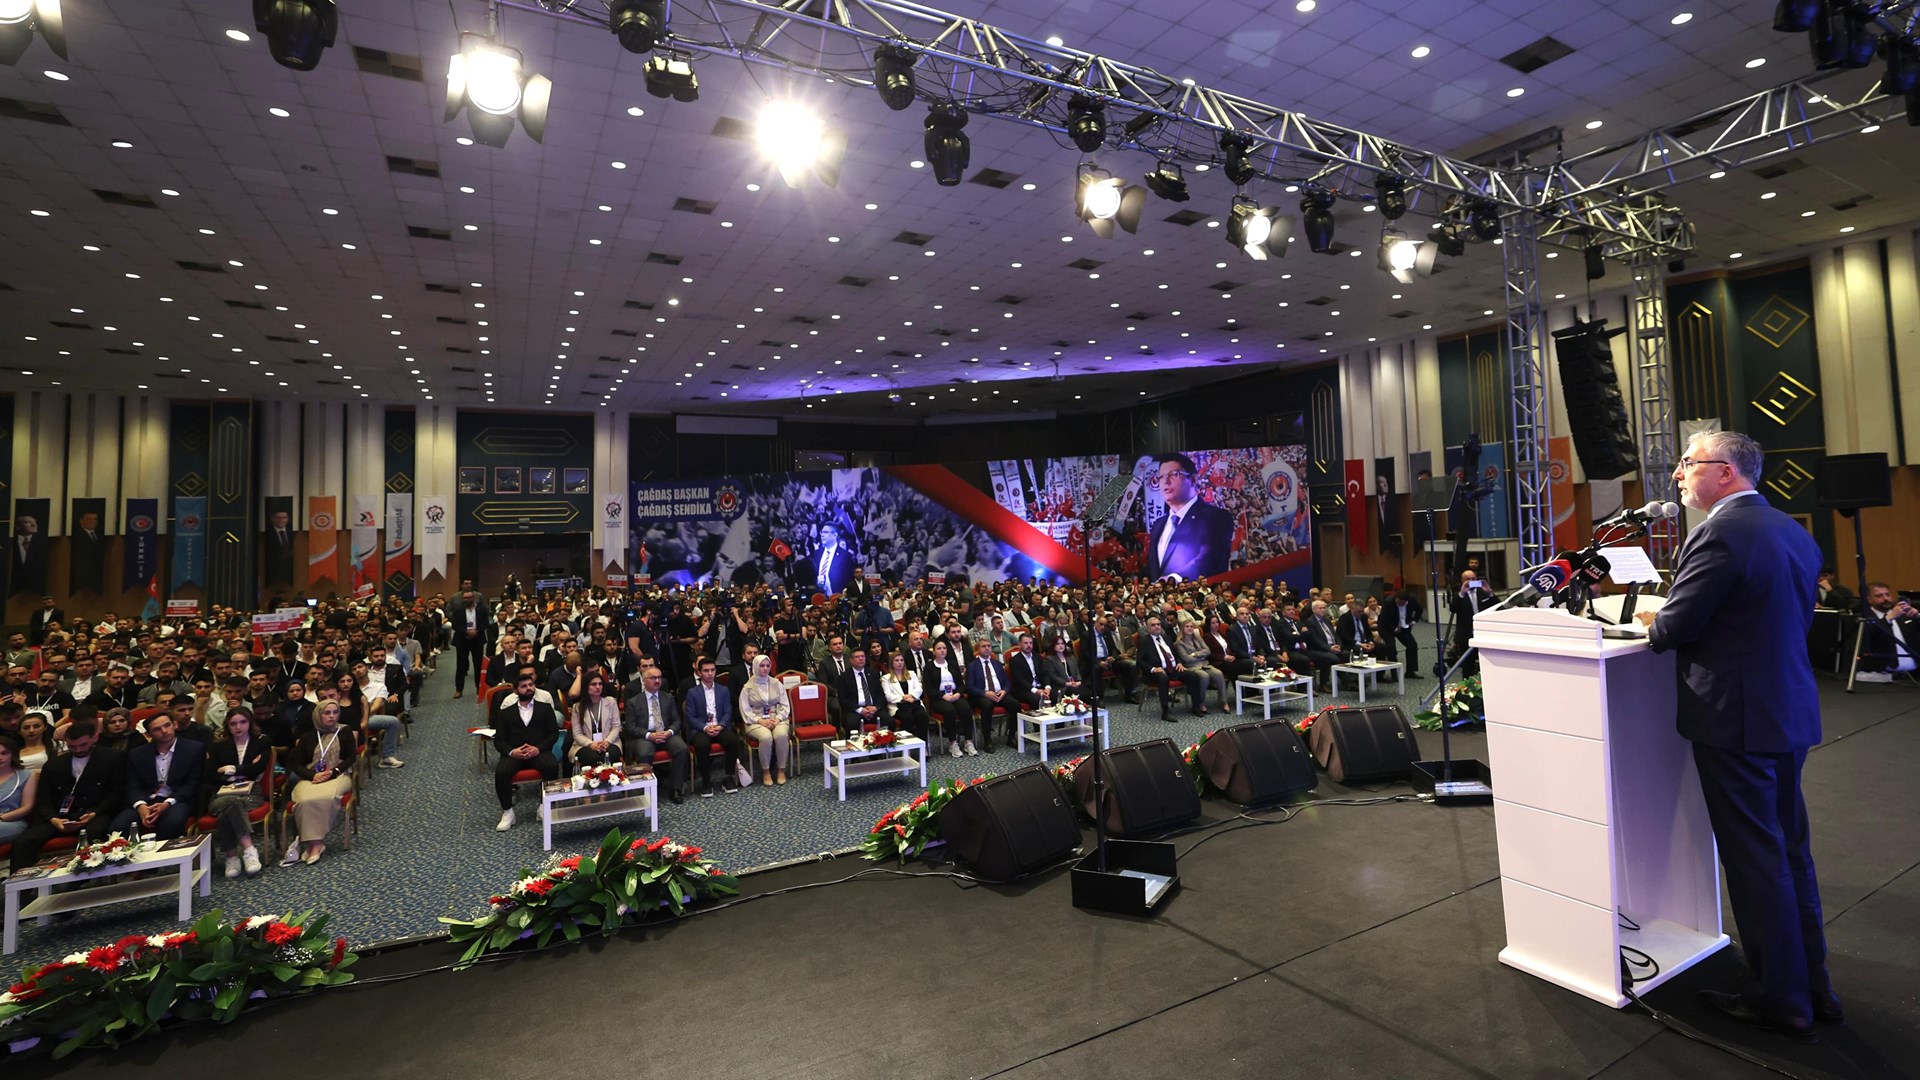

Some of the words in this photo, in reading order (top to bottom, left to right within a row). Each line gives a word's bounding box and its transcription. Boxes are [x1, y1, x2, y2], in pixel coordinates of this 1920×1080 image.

[638, 488, 672, 503] ÇAĞDAŞ
[674, 488, 709, 501] BAŞKAN
[638, 504, 672, 519] ÇAĞDAŞ
[674, 502, 711, 516] SENDİKA
[1589, 564, 1605, 576] TRT
